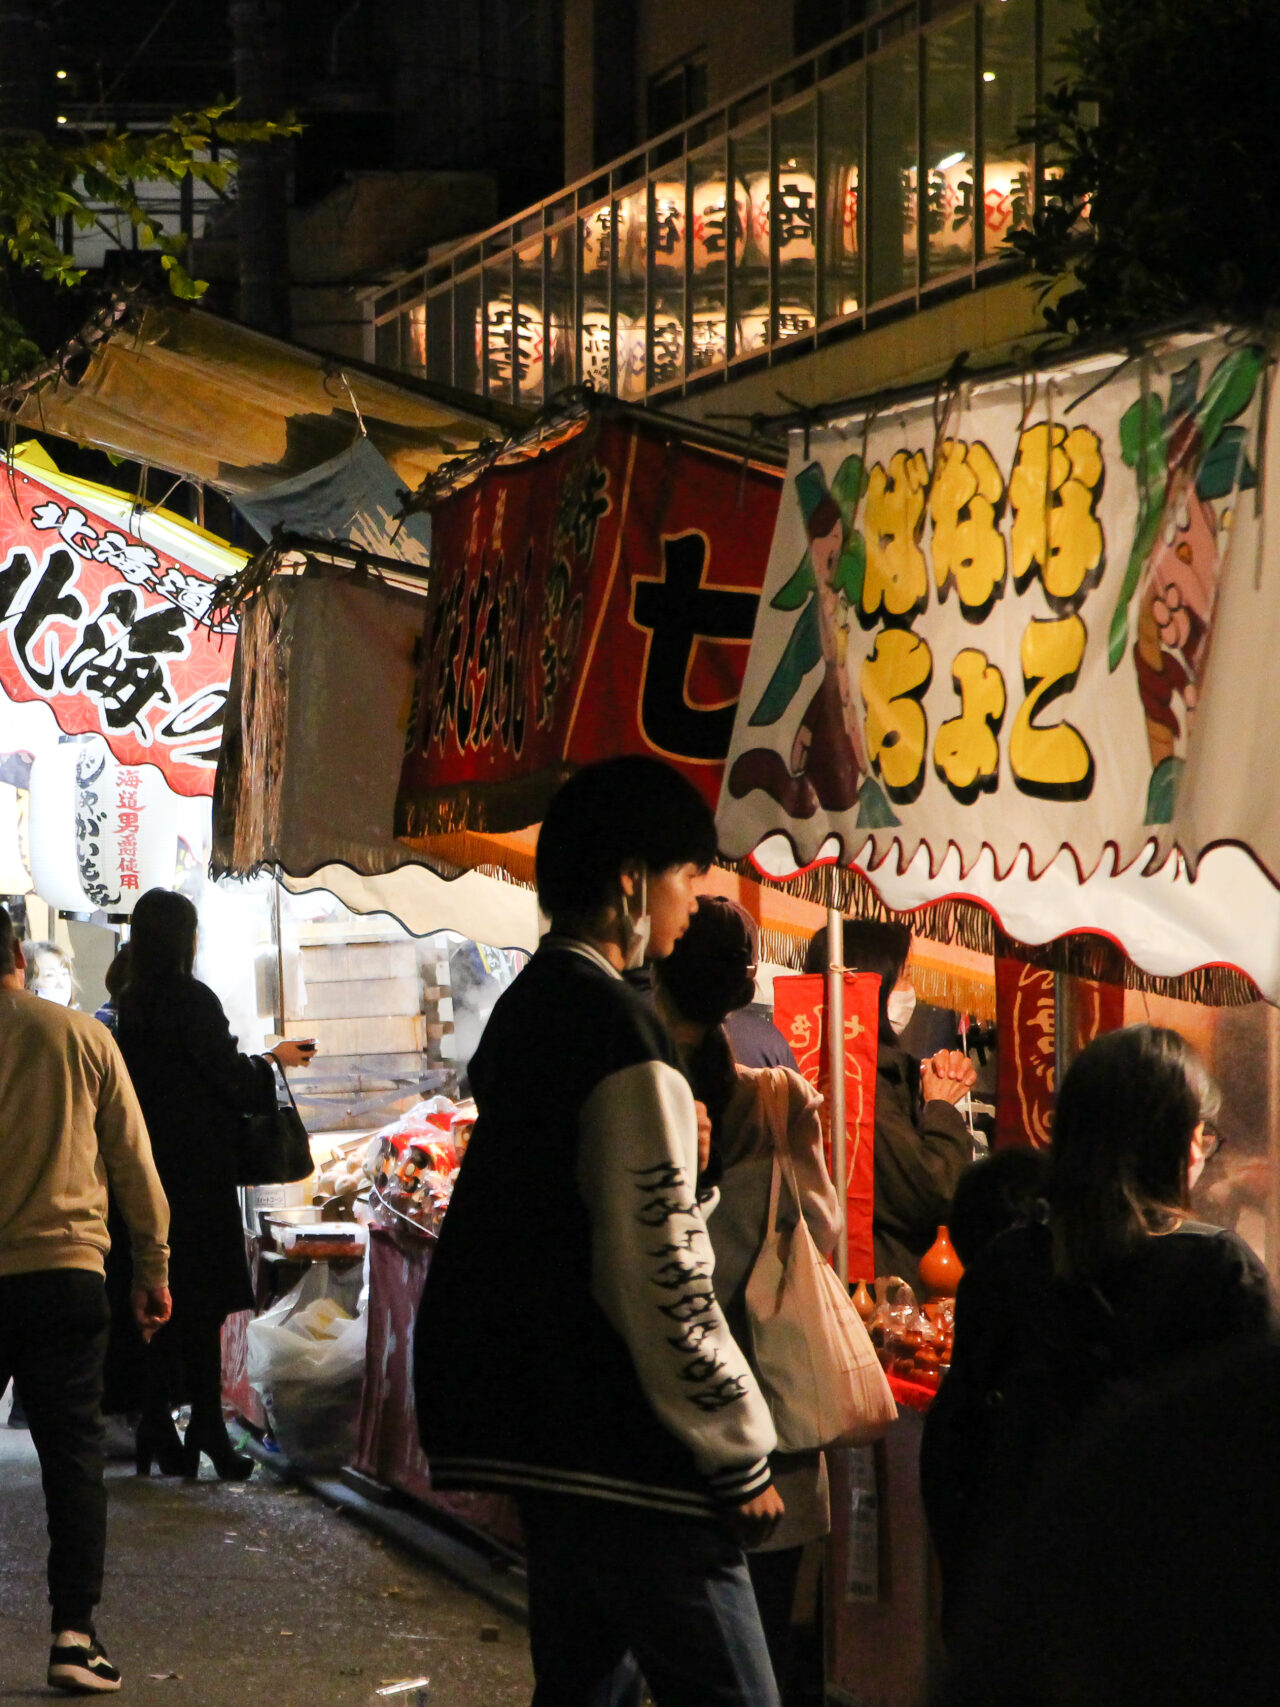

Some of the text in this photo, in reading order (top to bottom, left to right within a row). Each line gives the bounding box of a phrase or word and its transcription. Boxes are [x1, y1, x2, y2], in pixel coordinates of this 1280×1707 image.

[860, 614, 1096, 805] ちょこ
[112, 763, 148, 890] 海道男爵使用
[631, 1161, 749, 1412] BROOKLYN
